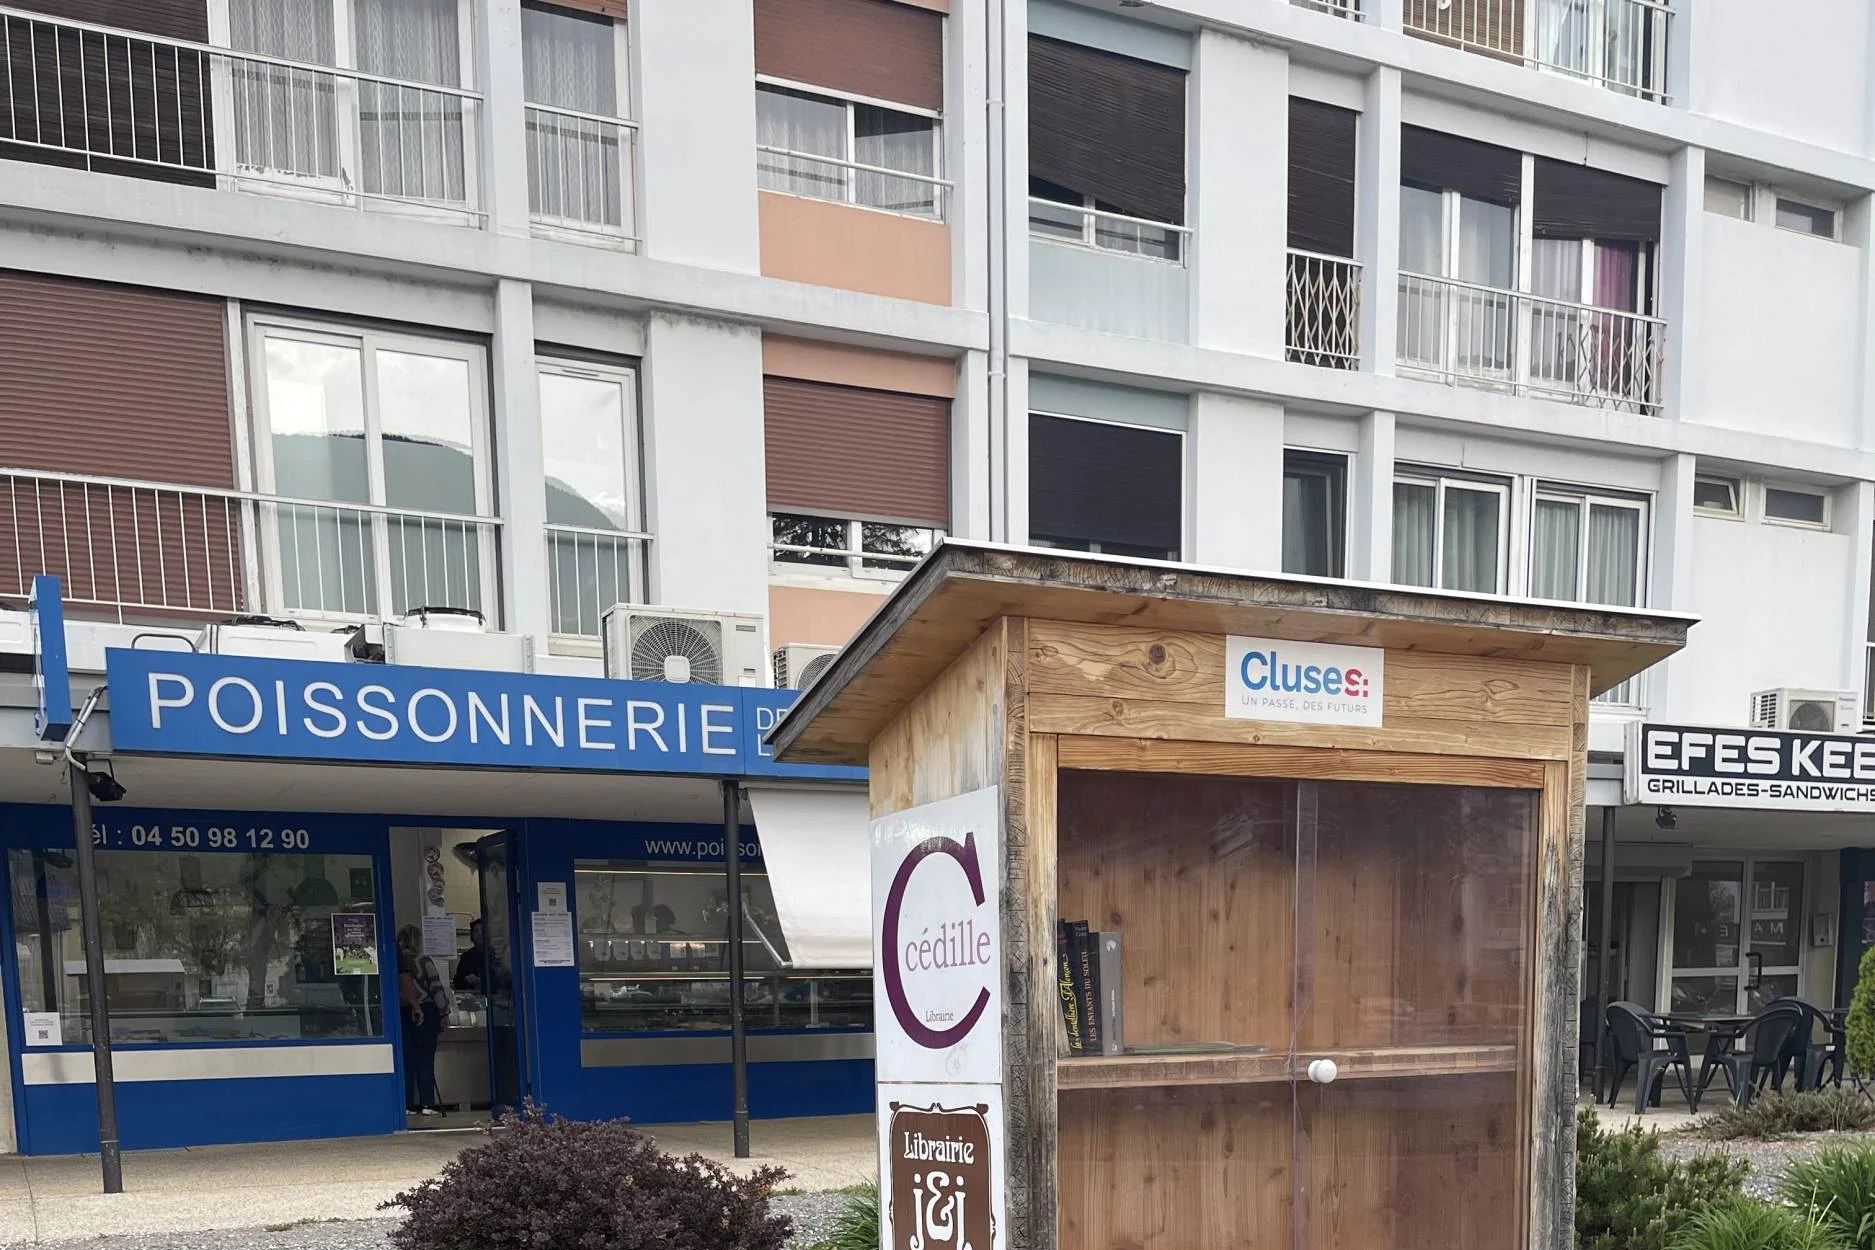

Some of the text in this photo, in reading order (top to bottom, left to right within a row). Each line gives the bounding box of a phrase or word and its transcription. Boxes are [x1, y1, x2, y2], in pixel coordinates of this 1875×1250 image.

[148, 672, 737, 756] POISSONNERIE
[1303, 701, 1323, 712] DES
[1327, 702, 1368, 714] FUTURS
[1647, 730, 1781, 775] EFES
[131, 825, 162, 846] 04
[170, 826, 200, 847] 50
[207, 827, 237, 848] 98
[246, 828, 274, 848] 12
[281, 829, 310, 849] 90
[905, 918, 991, 972] cédille
[925, 1010, 954, 1023] Librairie
[1086, 991, 1096, 1025] ENFANTS
[903, 1131, 975, 1164] Librairie
